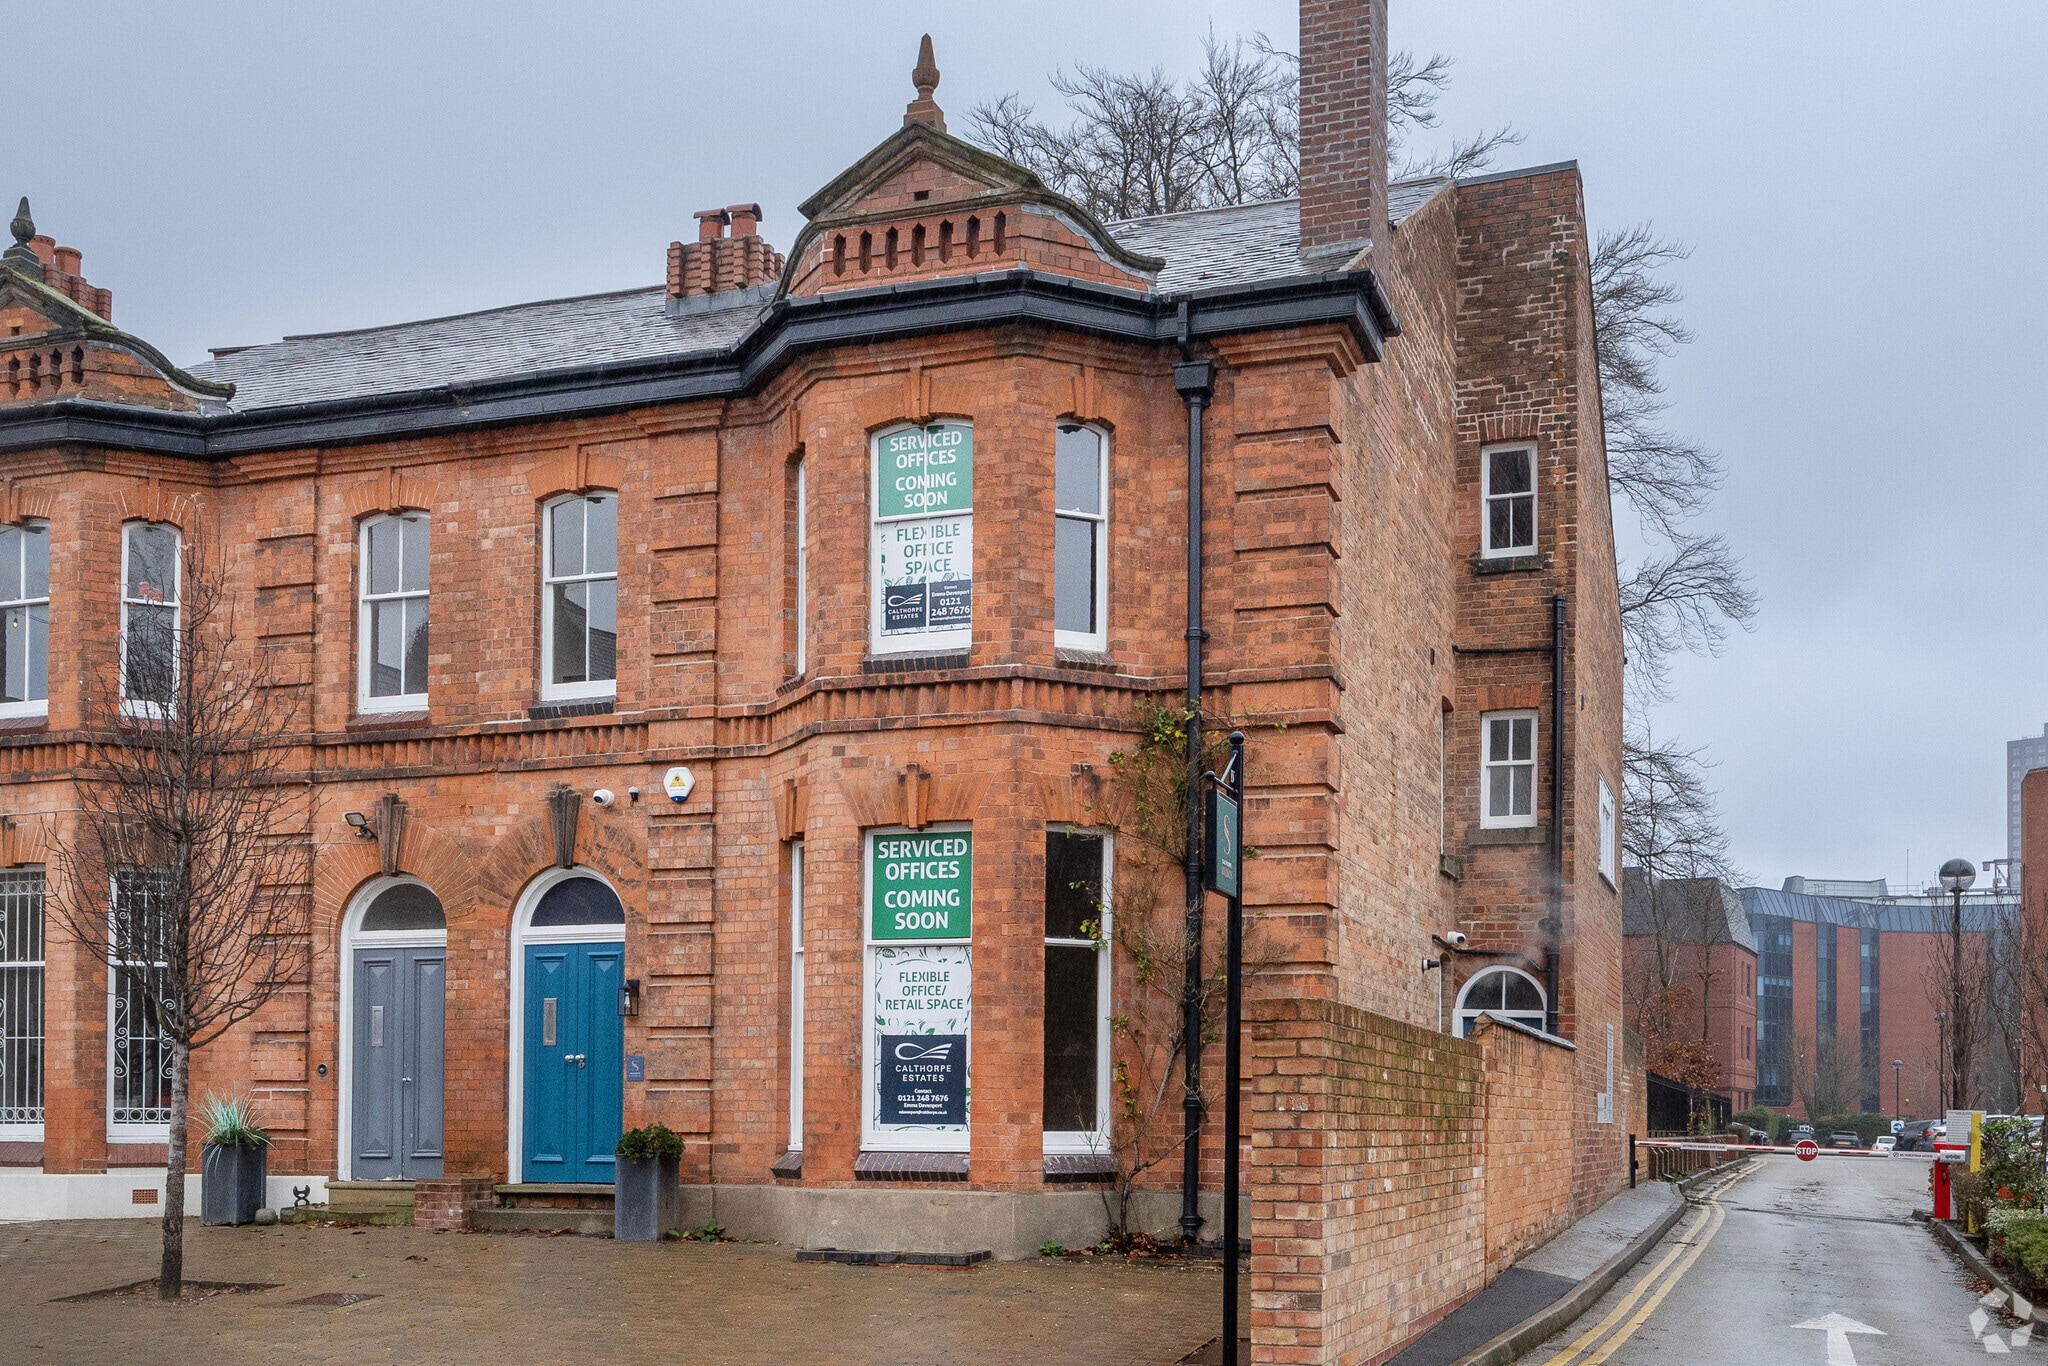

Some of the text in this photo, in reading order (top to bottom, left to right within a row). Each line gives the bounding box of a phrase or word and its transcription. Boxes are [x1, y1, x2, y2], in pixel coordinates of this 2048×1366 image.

[890, 431, 962, 452] SERVICED
[895, 471, 957, 491] COMING
[904, 490, 948, 508] SOON
[905, 558, 951, 575] SPACE
[940, 597, 961, 606] 0121
[887, 607, 923, 615] CALTHORPE
[931, 605, 970, 617] 248 7676
[878, 838, 968, 859] SERVICED
[885, 860, 960, 881] OFFICES
[884, 888, 960, 908] COMING
[894, 911, 949, 930] SOON
[899, 971, 950, 982] FLEXIBLE
[902, 985, 947, 996] OFFICE/
[885, 998, 964, 1010] RETAIL SPACE
[895, 1064, 952, 1073] CALTHORPE
[902, 1074, 945, 1082] ESTATES
[897, 1094, 949, 1102] 0121 248 7676
[1796, 1146, 1818, 1156] STOP
